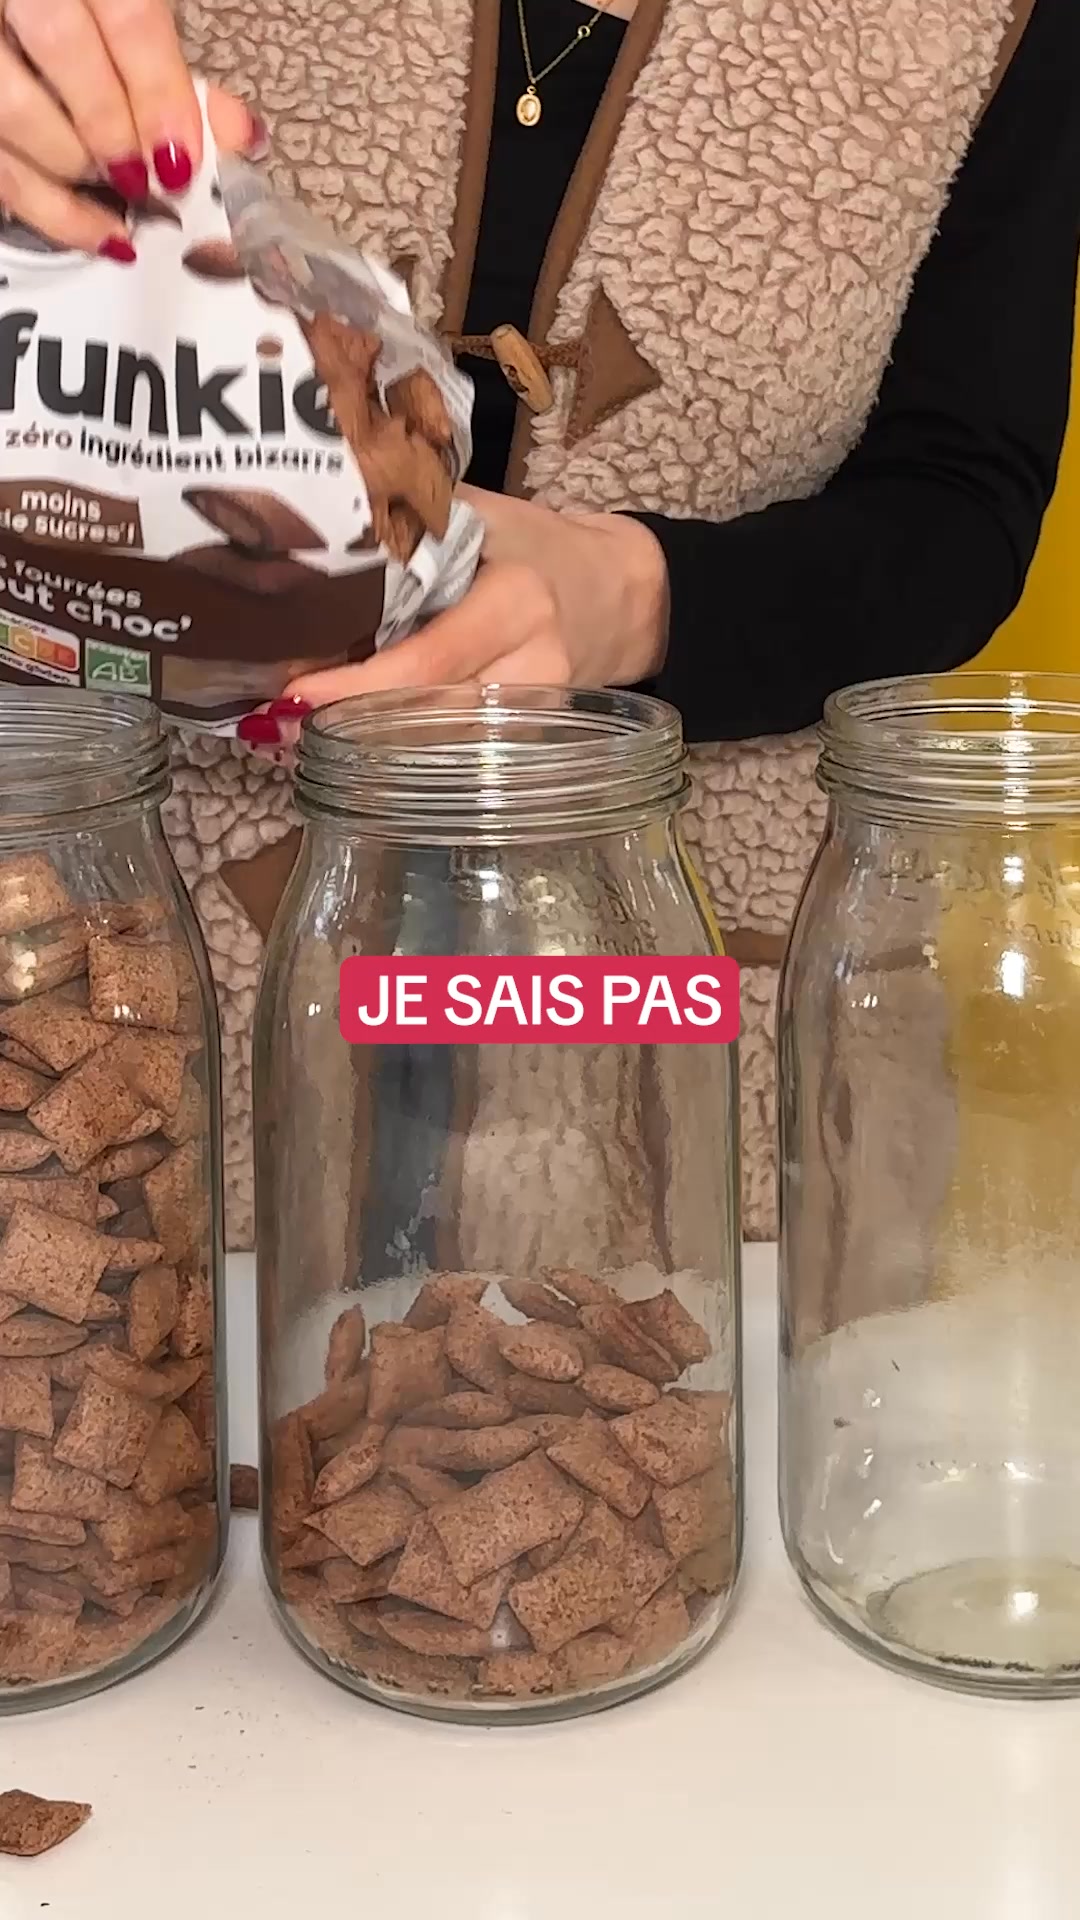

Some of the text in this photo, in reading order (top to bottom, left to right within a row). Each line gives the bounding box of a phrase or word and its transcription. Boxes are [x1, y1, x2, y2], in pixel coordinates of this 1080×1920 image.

[5, 421, 73, 450] zéro
[80, 425, 227, 475] ingrédient
[20, 488, 101, 523] moins
[14, 559, 142, 609] fourrées
